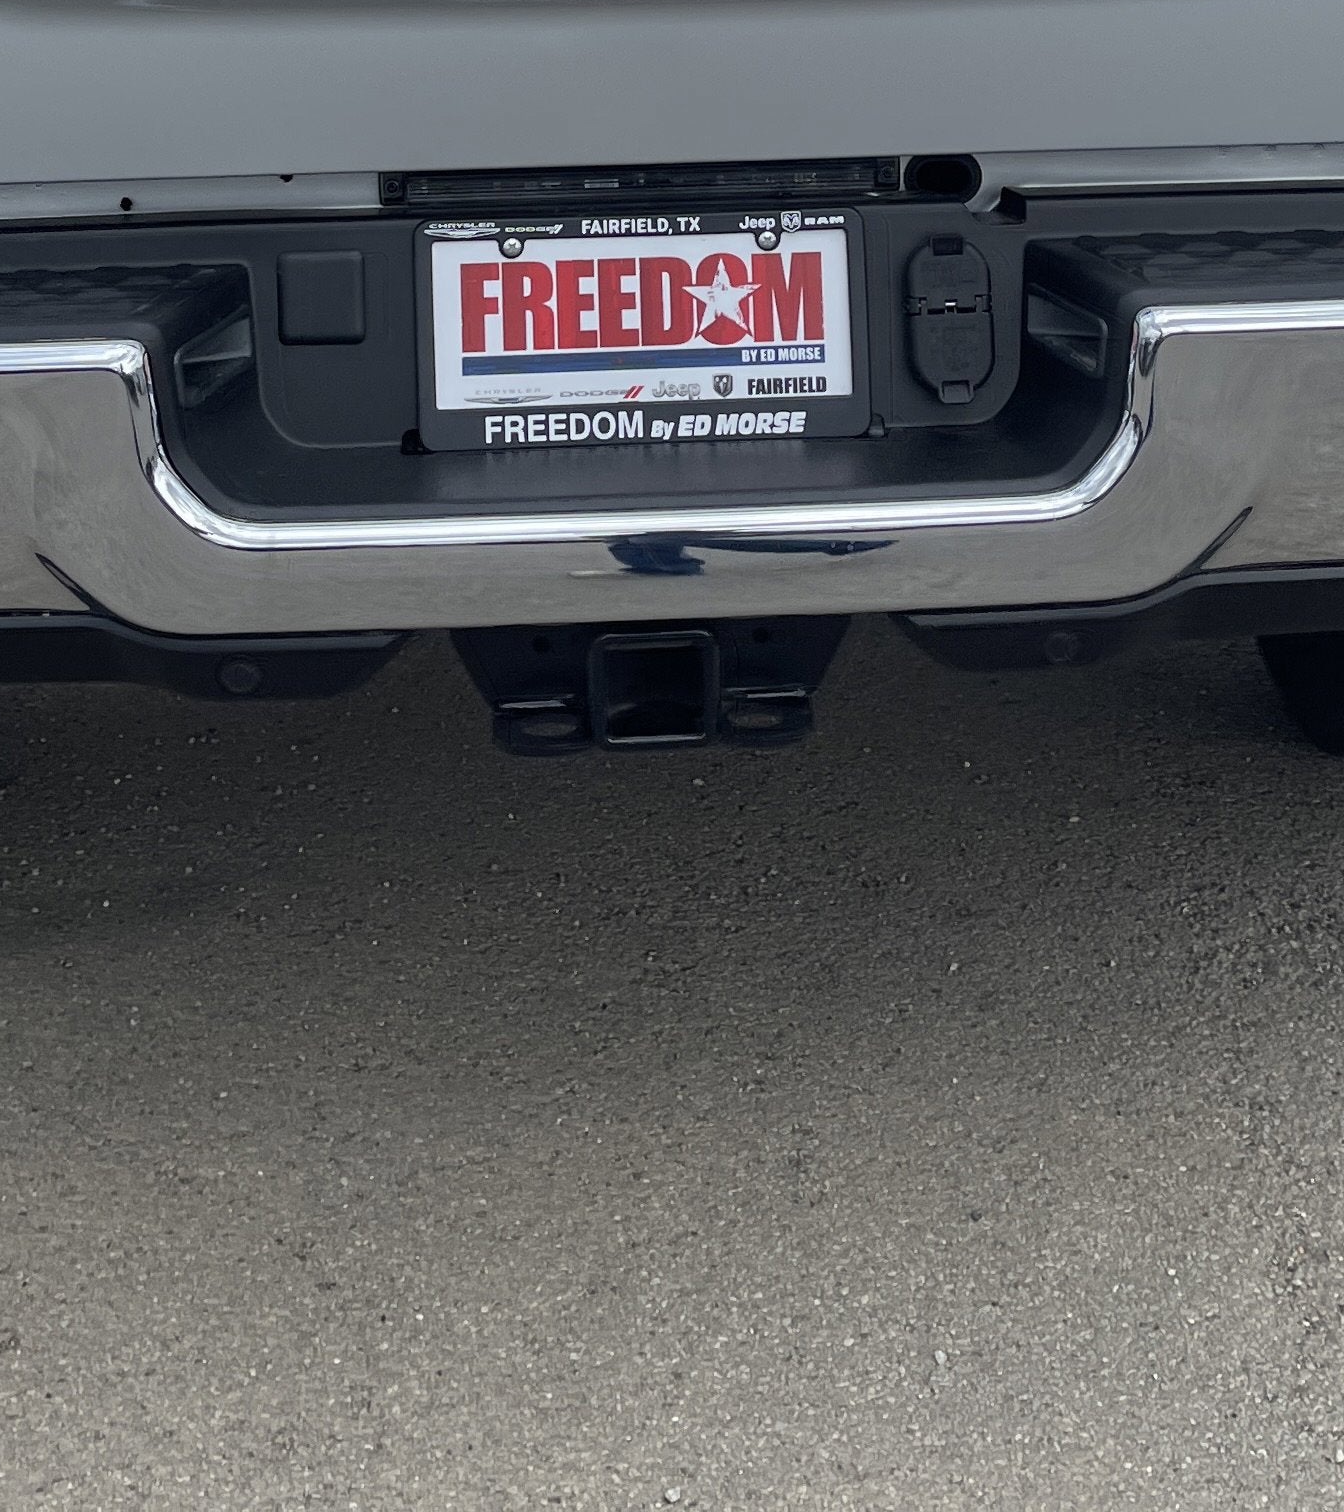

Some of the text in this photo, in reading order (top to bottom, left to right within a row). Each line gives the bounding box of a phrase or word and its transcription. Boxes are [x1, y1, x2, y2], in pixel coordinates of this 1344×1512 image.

[581, 216, 701, 235] FAIRFIELD, TX
[739, 216, 776, 230] Jeep
[804, 215, 845, 226] RAM
[460, 251, 825, 353] FREEDOM
[741, 346, 821, 363] BY ED MORSE
[474, 387, 542, 395] CHRYSLER
[652, 380, 701, 400] Jeep
[747, 376, 827, 396] FAIRFIELD
[485, 410, 807, 444] FREEDOM By ED MORSE
